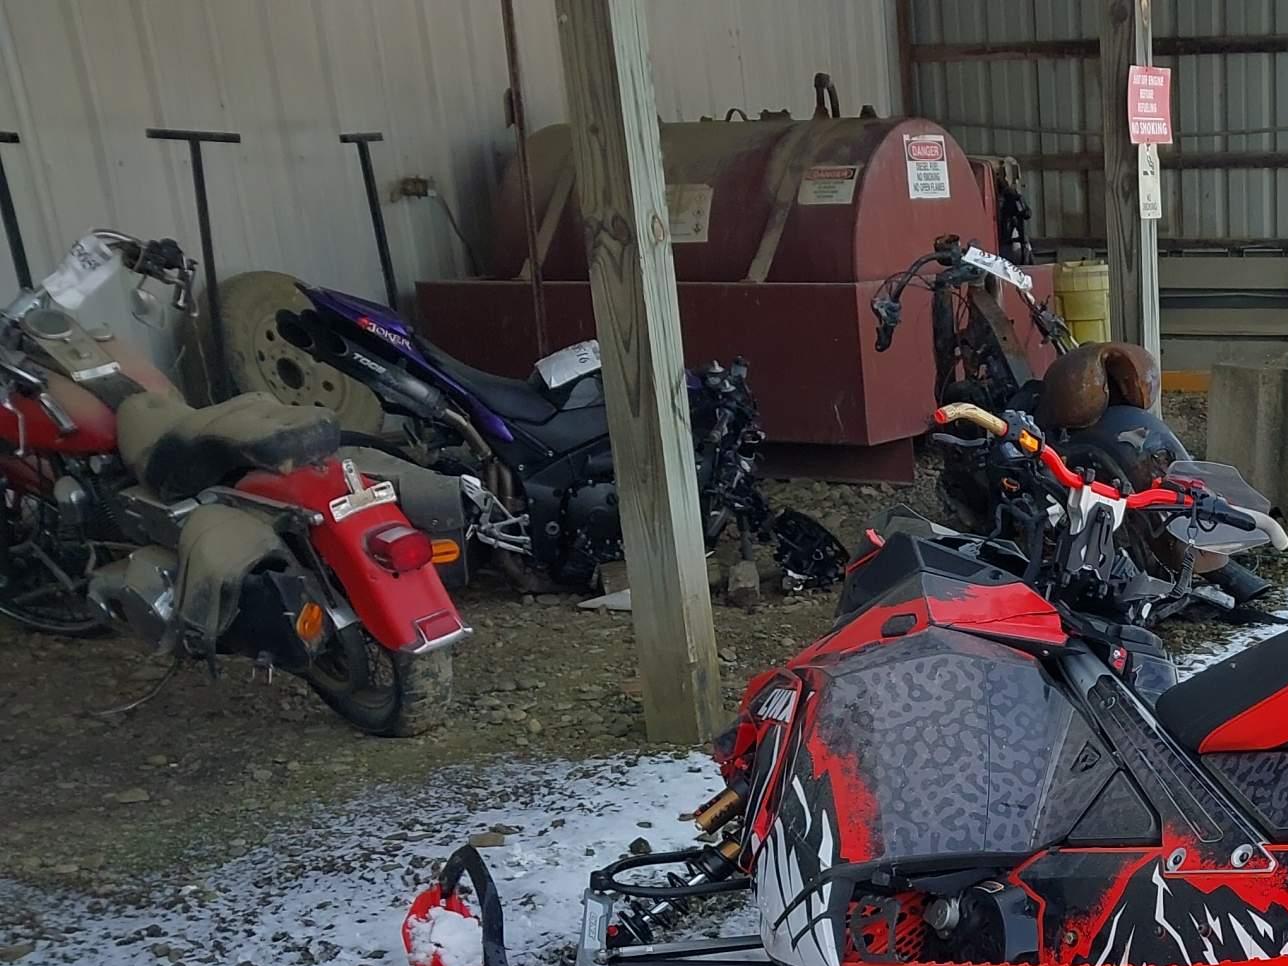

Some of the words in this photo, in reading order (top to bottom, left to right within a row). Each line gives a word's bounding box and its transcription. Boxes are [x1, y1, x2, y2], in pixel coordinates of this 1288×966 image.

[1132, 122, 1139, 134] NO
[1140, 122, 1168, 135] SMOKING
[911, 145, 940, 156] DANGER
